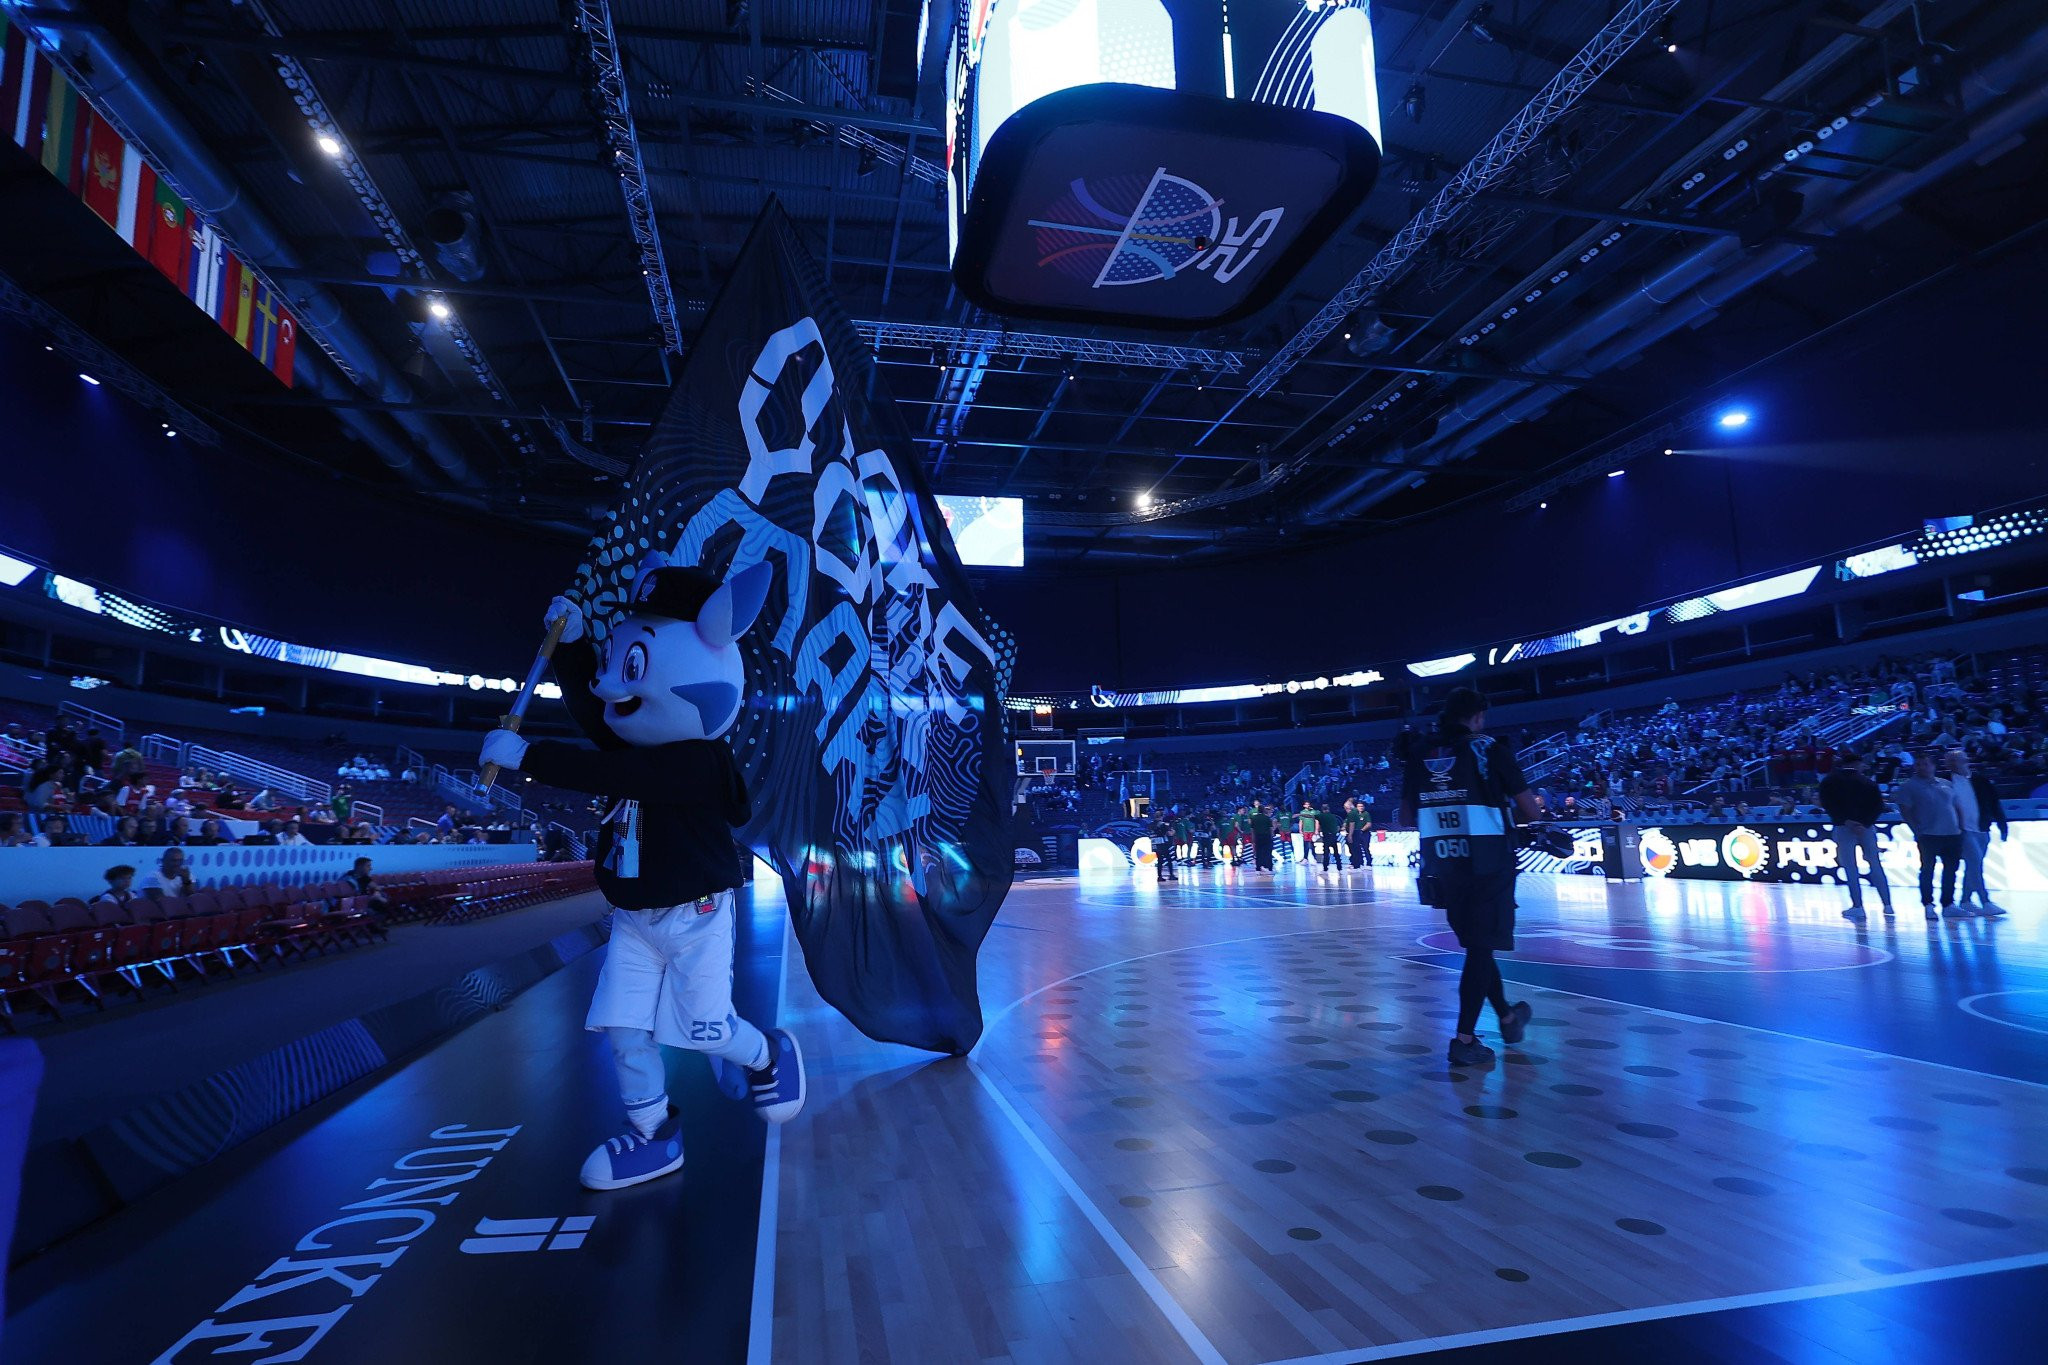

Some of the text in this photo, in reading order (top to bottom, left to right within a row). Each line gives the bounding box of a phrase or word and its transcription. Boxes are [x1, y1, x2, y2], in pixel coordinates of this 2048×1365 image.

[1436, 811, 1461, 829] HB
[1434, 838, 1470, 859] 050
[1678, 839, 1719, 866] VS
[691, 1020, 723, 1041] 25
